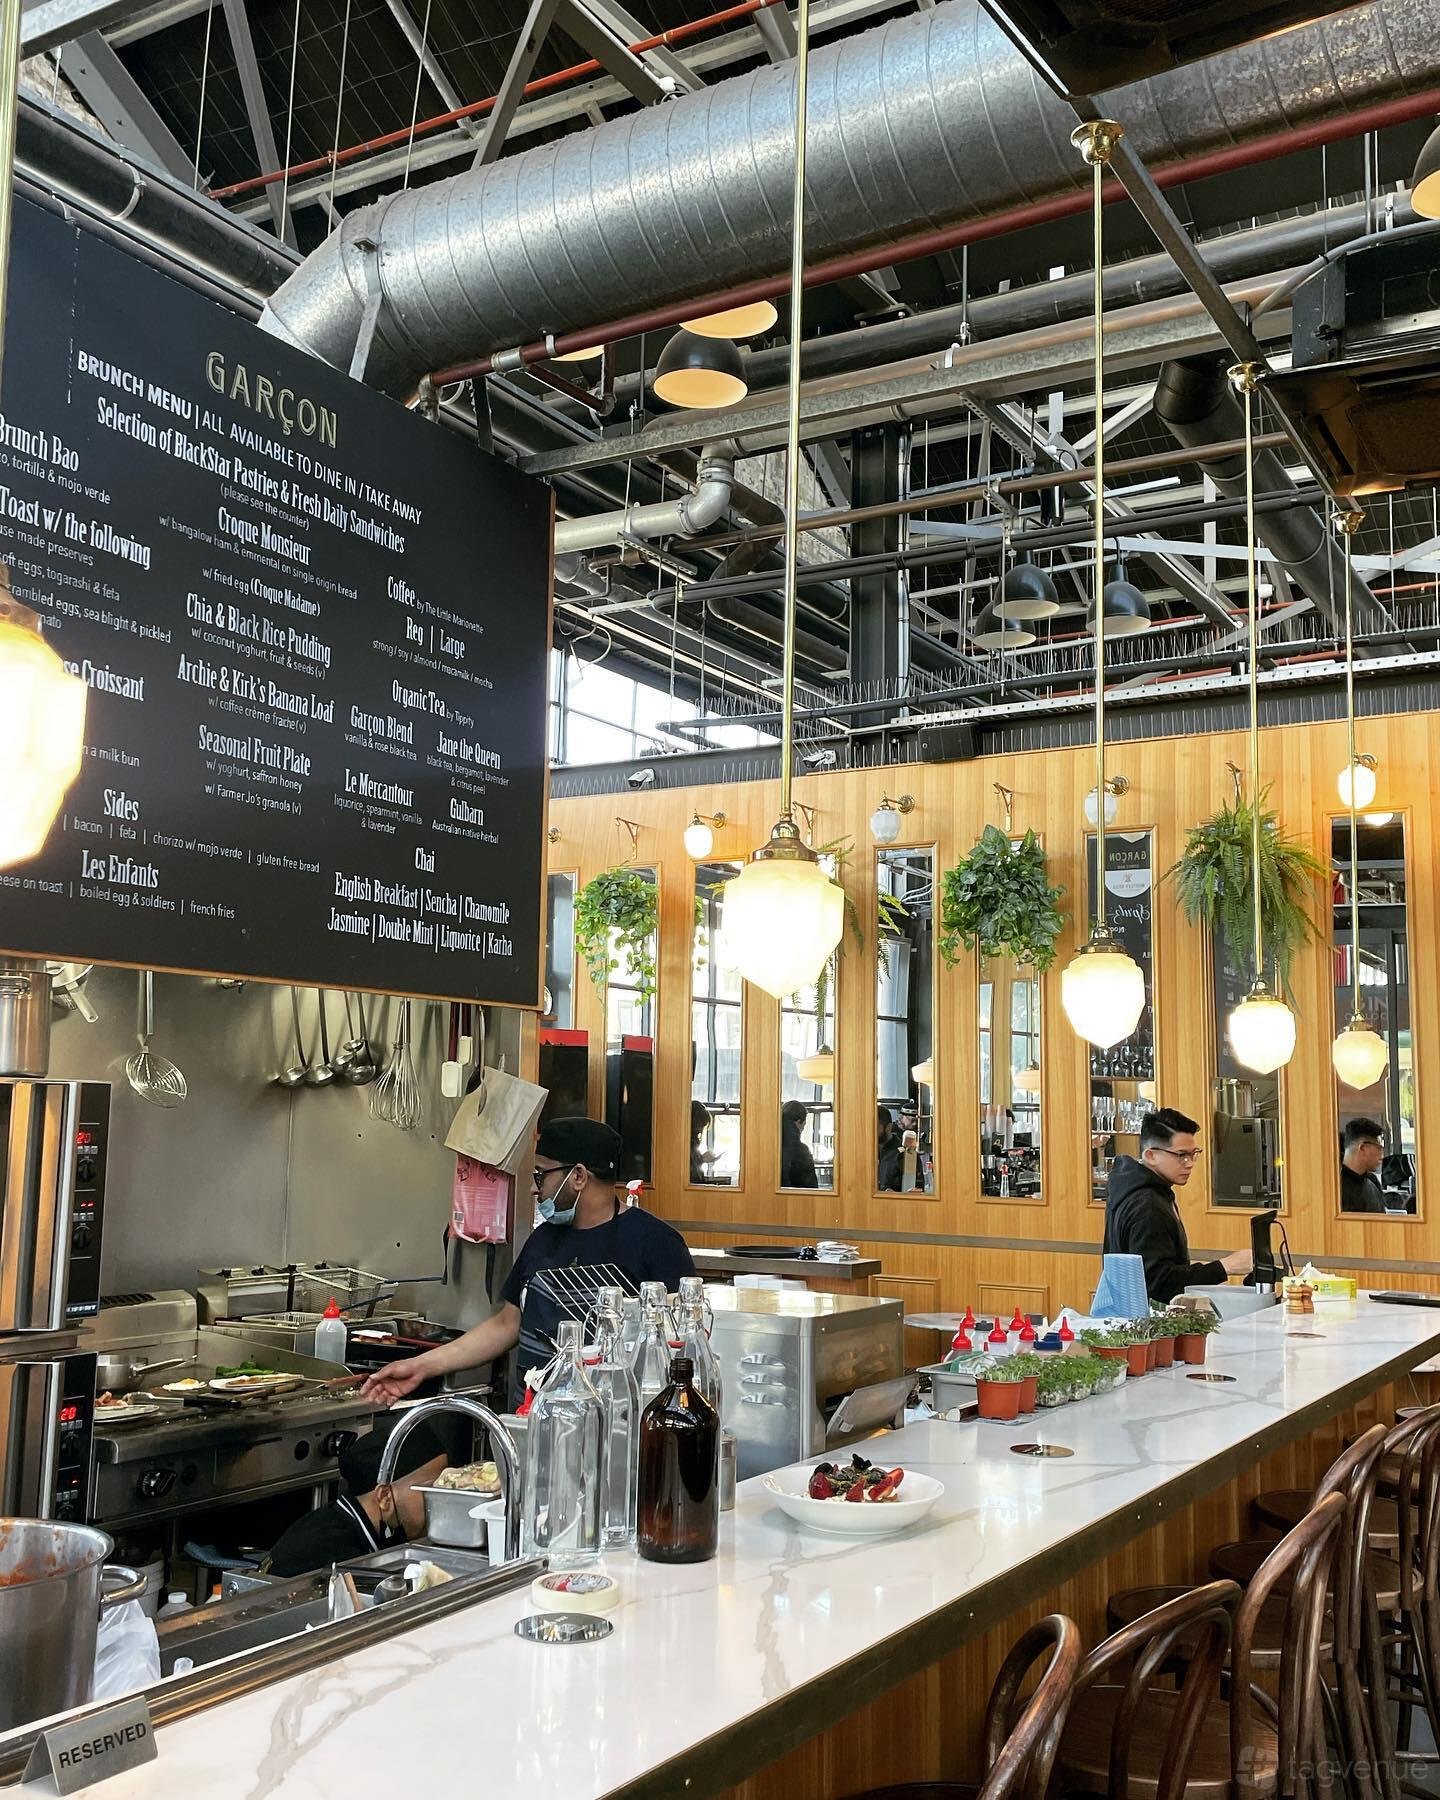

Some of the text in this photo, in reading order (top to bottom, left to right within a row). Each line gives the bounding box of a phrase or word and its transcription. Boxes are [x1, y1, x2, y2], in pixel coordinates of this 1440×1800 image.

[205, 351, 337, 449] GARÇON
[51, 435, 80, 472] Bao
[77, 350, 422, 525] BRUNCH MENU ALL AVAILABLE TO DINE IN TAKE AWAY
[12, 455, 45, 479] tortilla
[47, 469, 56, 483] &
[58, 475, 82, 494] mojo
[84, 486, 111, 504] verde
[97, 396, 405, 554] Selection of BlackStar Pastries & Fresh Daily Sandwiches
[0, 484, 151, 571] Toast w/ the following
[220, 482, 310, 531] (please see the counter)
[17, 530, 46, 549] made
[47, 541, 94, 566] preserves
[218, 506, 312, 566] Croque Monsieur
[171, 517, 212, 543] bangalow
[213, 534, 232, 551] ham
[233, 542, 240, 554] &
[281, 563, 291, 574] on
[292, 566, 315, 584] single
[315, 577, 337, 593] origin
[337, 582, 358, 600] bread
[17, 559, 121, 601] eggs, togarashi & feta
[213, 568, 321, 617] fried egg (Croque Madame)
[387, 575, 416, 607] Coffee
[56, 599, 82, 618] eggs,
[83, 607, 100, 621] sea
[101, 611, 130, 631] blight
[130, 621, 138, 633] &
[139, 624, 172, 644] pickled
[186, 592, 331, 669] Chia & Black Rice Pudding
[406, 616, 465, 660] Reg Large
[203, 631, 236, 650] coconut
[269, 649, 285, 665] fruit
[286, 656, 293, 669] &
[81, 659, 145, 701] Croissant
[177, 653, 335, 724] Archie & Kirk's Banana Loaf
[392, 679, 446, 717] Organic Tea
[219, 698, 244, 715] coffee
[350, 705, 413, 745] Garçon Blend
[99, 748, 120, 763] milk
[121, 750, 140, 767] bun
[198, 724, 311, 776] Seasonal Fruit Plate
[344, 733, 417, 761] vanilla rose black tea
[436, 731, 501, 770] Jane the Queen
[217, 784, 246, 801] Farmer
[261, 798, 291, 812] granola
[252, 769, 278, 785] saffron
[279, 774, 303, 795] honey
[345, 768, 415, 807] Le Mercantour
[103, 788, 139, 821] Sides
[450, 797, 484, 826] Gulbarn
[73, 817, 103, 834] bacon
[119, 824, 137, 840] feta
[153, 831, 184, 849] chorizo
[197, 842, 219, 858] mojo
[220, 847, 243, 860] verde
[256, 852, 282, 866] gluten
[282, 855, 298, 869] free
[299, 859, 320, 873] bread
[432, 819, 462, 835] Australian
[462, 827, 481, 840] native
[81, 849, 160, 889] Les Enfants
[414, 847, 435, 873] Chai
[23, 878, 235, 919] on toast boiled egg & soldiers french fries
[334, 871, 510, 925] English Breakfast Sencha Chamomile
[327, 907, 369, 936] Jasmine
[378, 914, 411, 942] Double
[412, 919, 434, 946] Mint
[440, 925, 481, 953] Liquorice
[58, 1722, 147, 1769] RESERVED
